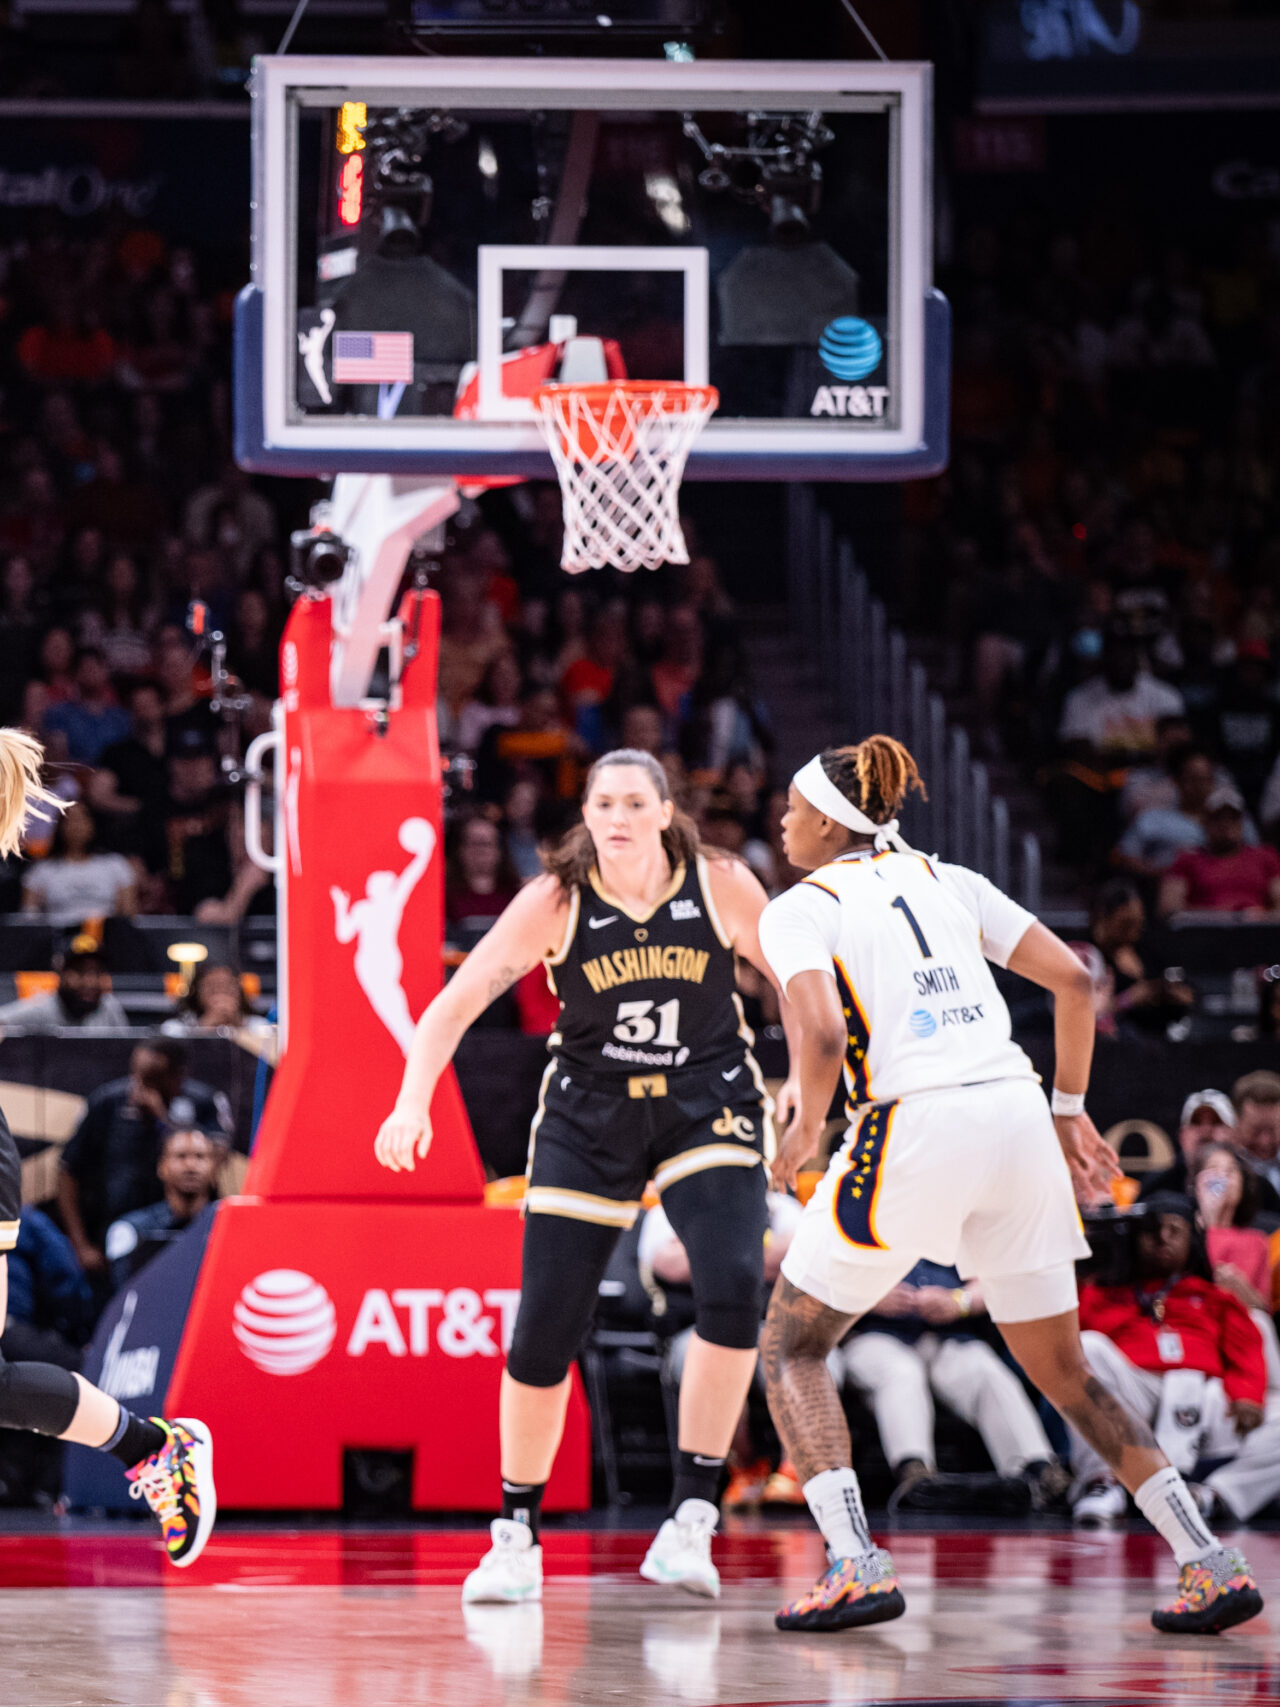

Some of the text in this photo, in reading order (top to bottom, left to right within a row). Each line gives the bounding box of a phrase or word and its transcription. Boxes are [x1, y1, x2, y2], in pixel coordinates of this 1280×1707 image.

[810, 385, 889, 417] AT&T
[890, 895, 933, 959] 1
[581, 945, 711, 995] WASHINGTON
[913, 966, 960, 996] SMITH
[613, 998, 681, 1048] 31
[941, 1004, 985, 1026] AT&T
[602, 1042, 674, 1067] Robinhood
[346, 1287, 521, 1358] AT&T
